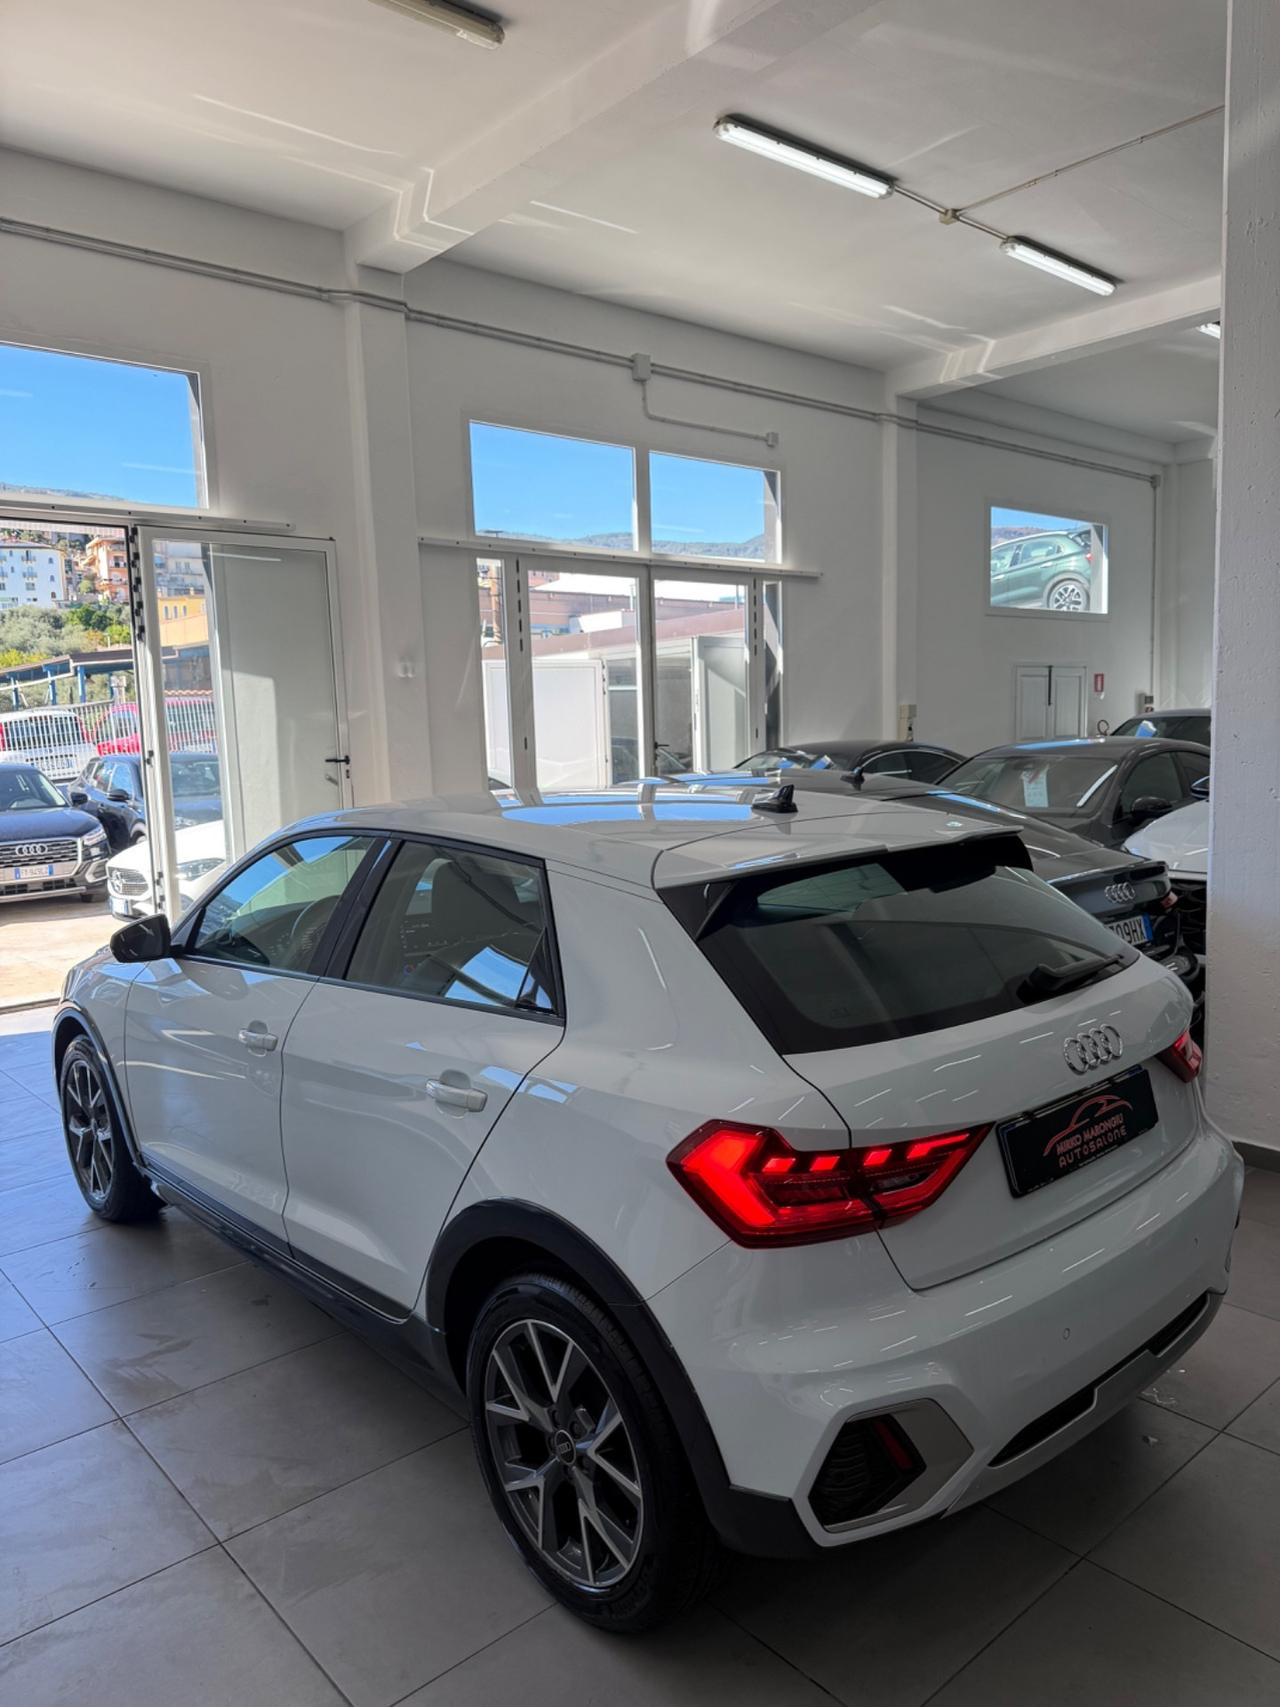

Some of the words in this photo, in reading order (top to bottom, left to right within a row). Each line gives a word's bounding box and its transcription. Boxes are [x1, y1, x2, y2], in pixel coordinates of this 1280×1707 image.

[1109, 918, 1145, 944] 09HX
[1056, 1134, 1082, 1156] MIRKO
[1059, 1125, 1127, 1168] AUTOSALONE
